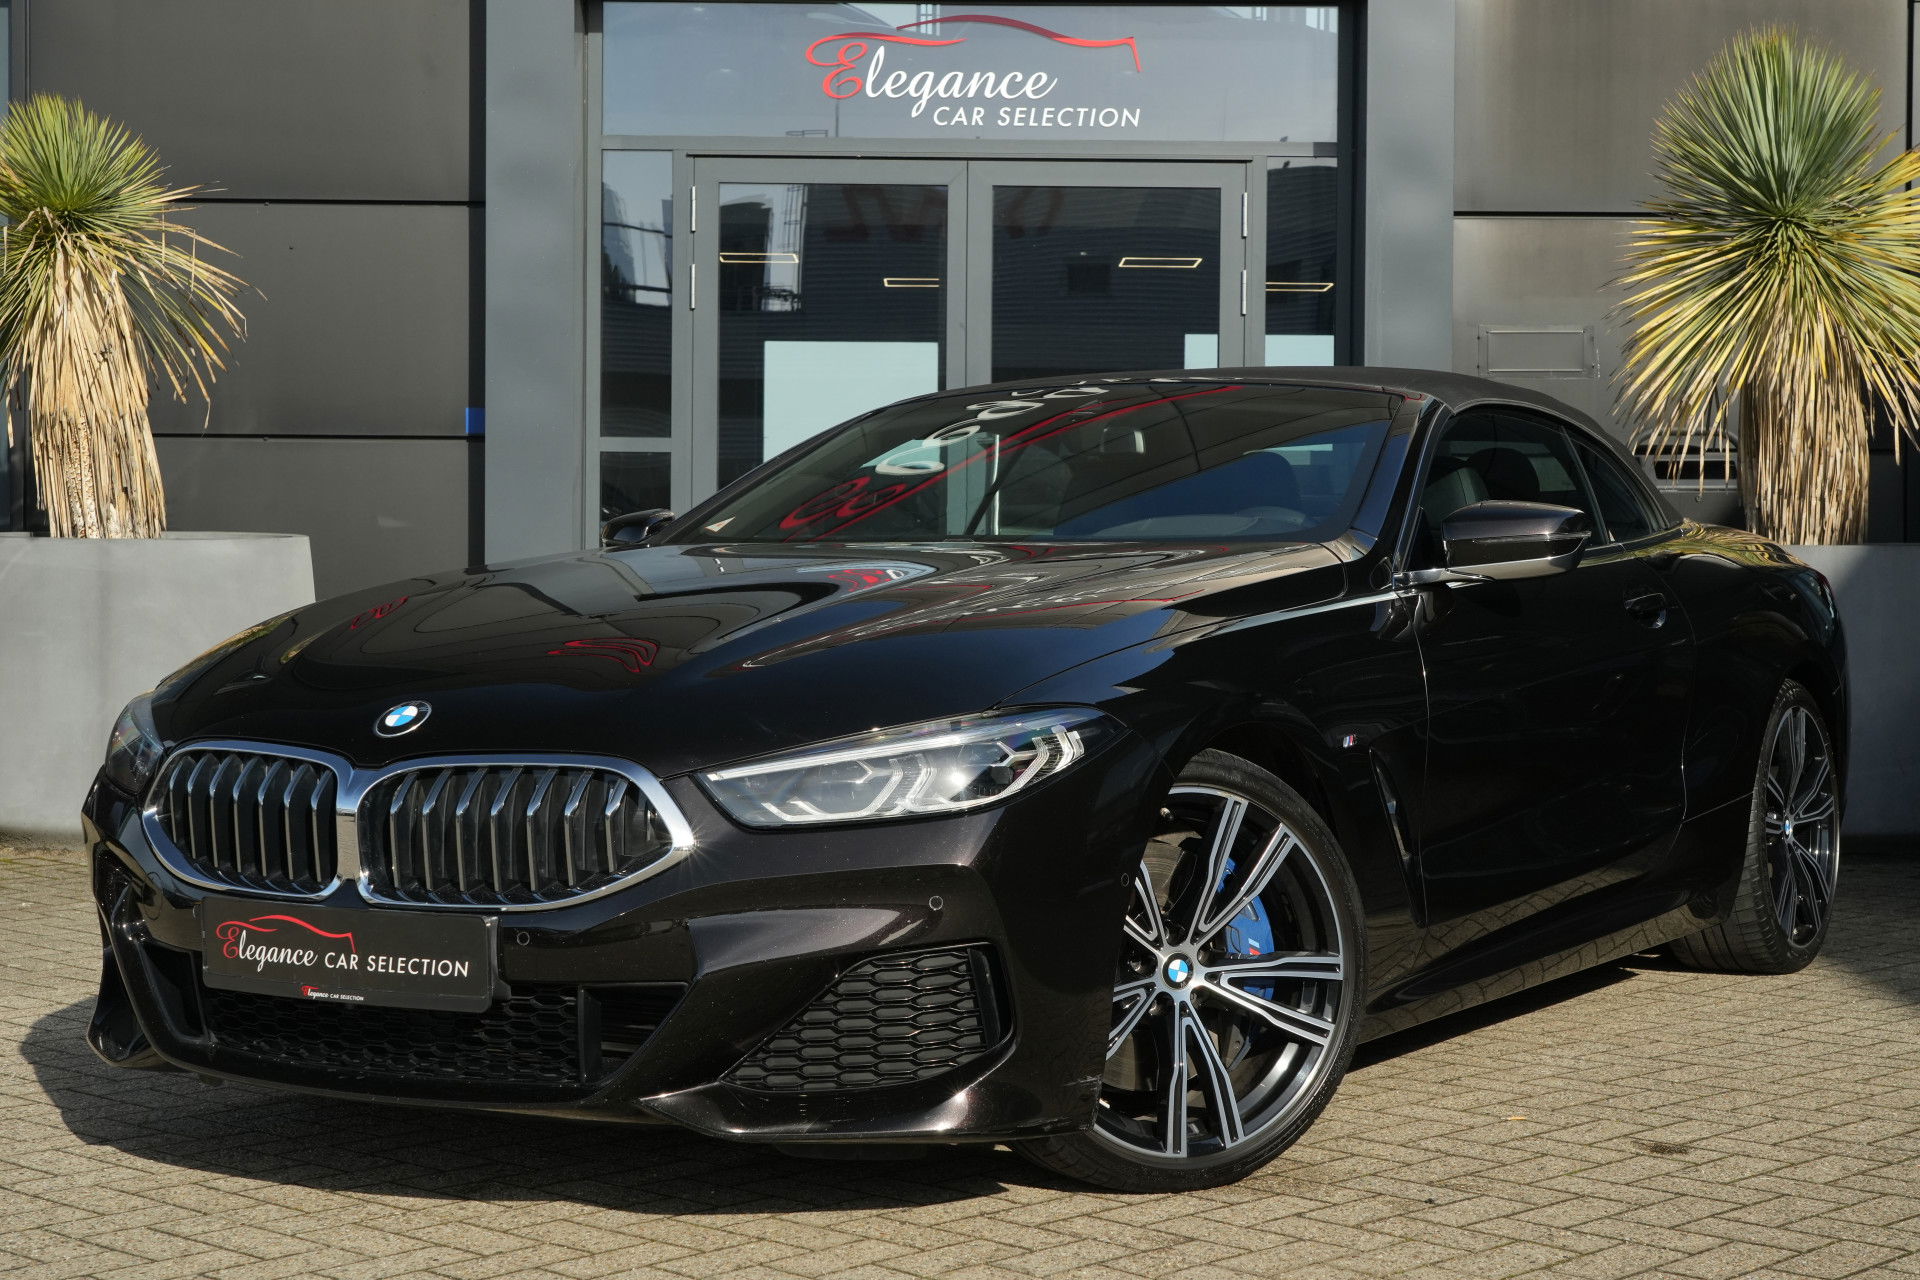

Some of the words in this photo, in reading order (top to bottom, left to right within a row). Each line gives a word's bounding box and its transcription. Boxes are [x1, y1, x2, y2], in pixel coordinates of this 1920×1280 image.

[805, 32, 1058, 118] Elegance
[933, 106, 985, 127] CAR
[997, 106, 1142, 128] SELECTION
[215, 920, 319, 973] Elegance
[324, 952, 359, 970] CAR
[367, 955, 470, 978] SELECTION
